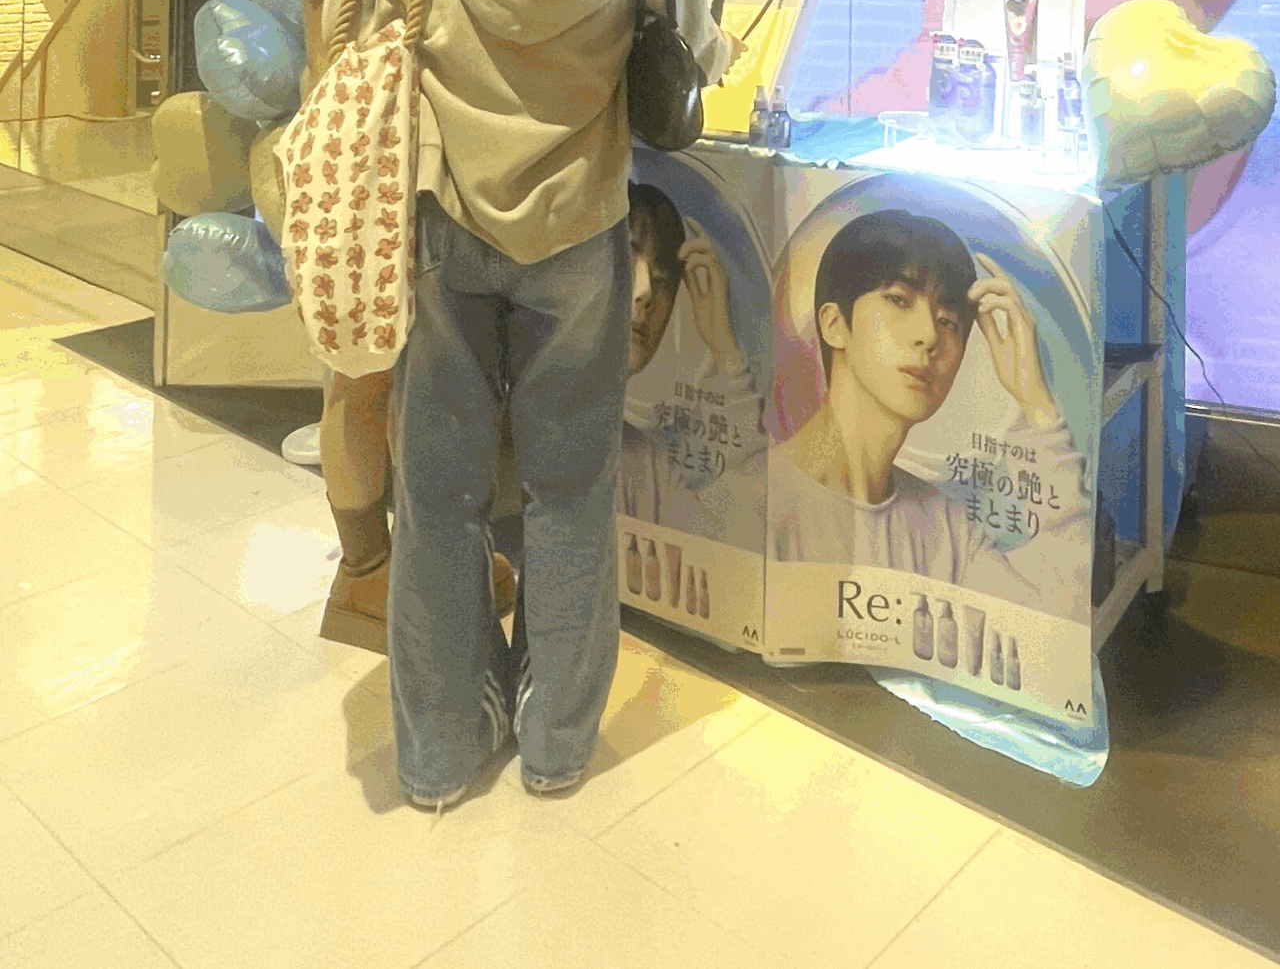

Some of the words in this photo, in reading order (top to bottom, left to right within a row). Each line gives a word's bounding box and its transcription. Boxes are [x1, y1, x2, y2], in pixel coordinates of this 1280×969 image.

[972, 432, 1037, 464] 目指すのは
[946, 452, 1061, 510] 究極の艶と
[965, 492, 1040, 541] まとまり
[837, 580, 903, 626] Re:
